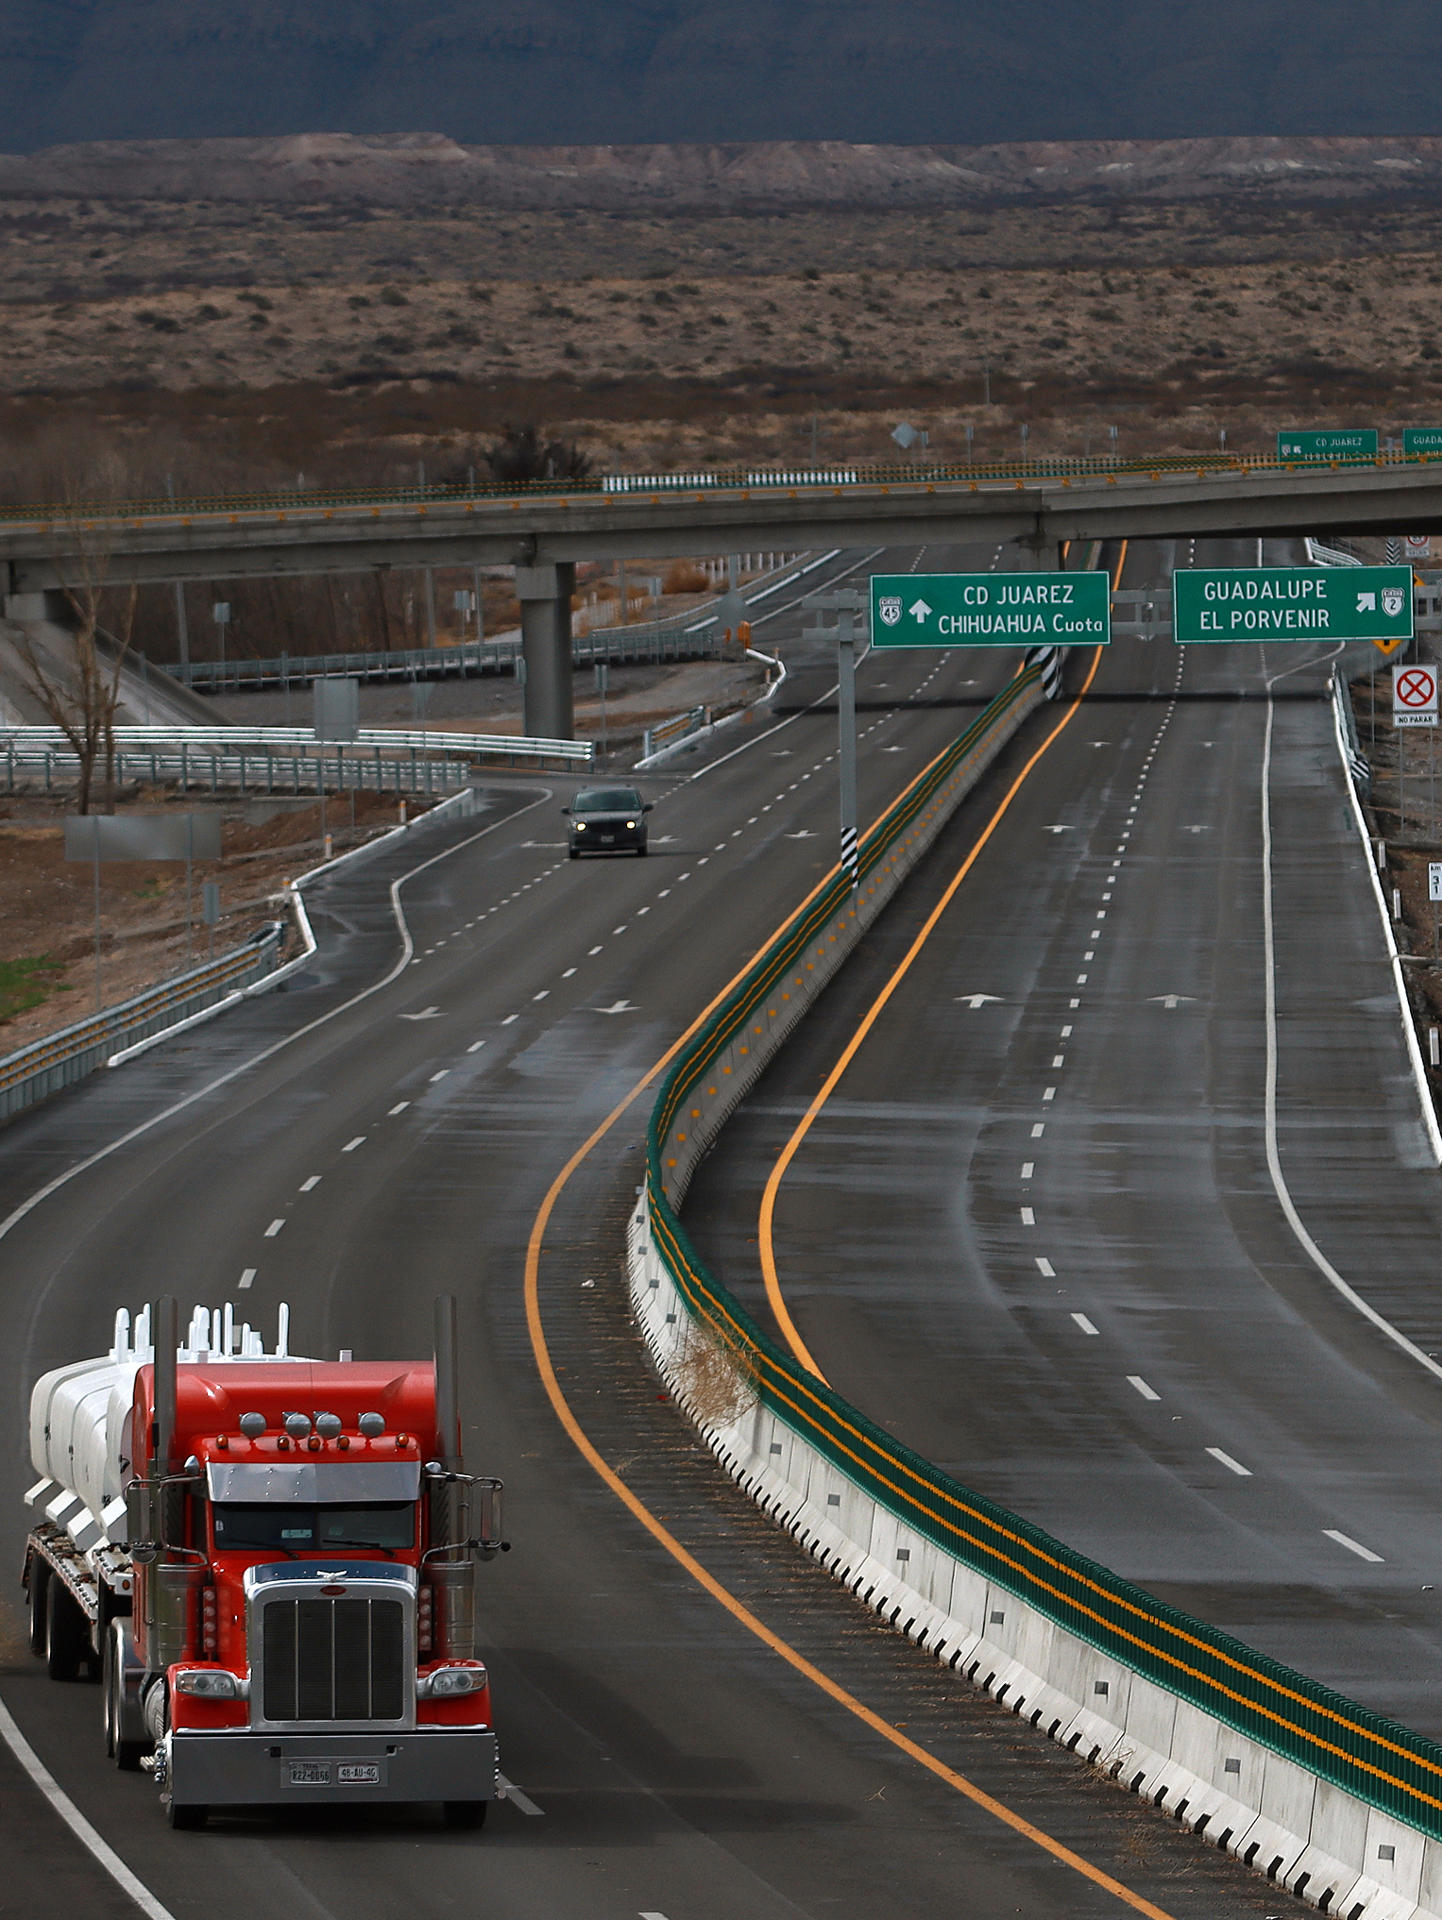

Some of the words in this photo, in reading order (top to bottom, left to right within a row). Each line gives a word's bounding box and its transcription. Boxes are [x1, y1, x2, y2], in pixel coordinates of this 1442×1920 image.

[1315, 437, 1327, 447] CD
[1330, 437, 1363, 447] JUAREZ
[963, 586, 989, 605] CD
[996, 585, 1074, 605] JUAREZ
[1204, 579, 1327, 600] GUADALUPE
[884, 606, 899, 619] 45
[1390, 599, 1396, 610] 2
[938, 614, 1046, 634] CHIHUAHUA
[1052, 613, 1103, 632] Cuota
[1200, 611, 1223, 630] EL
[1231, 609, 1330, 629] PORVENIR
